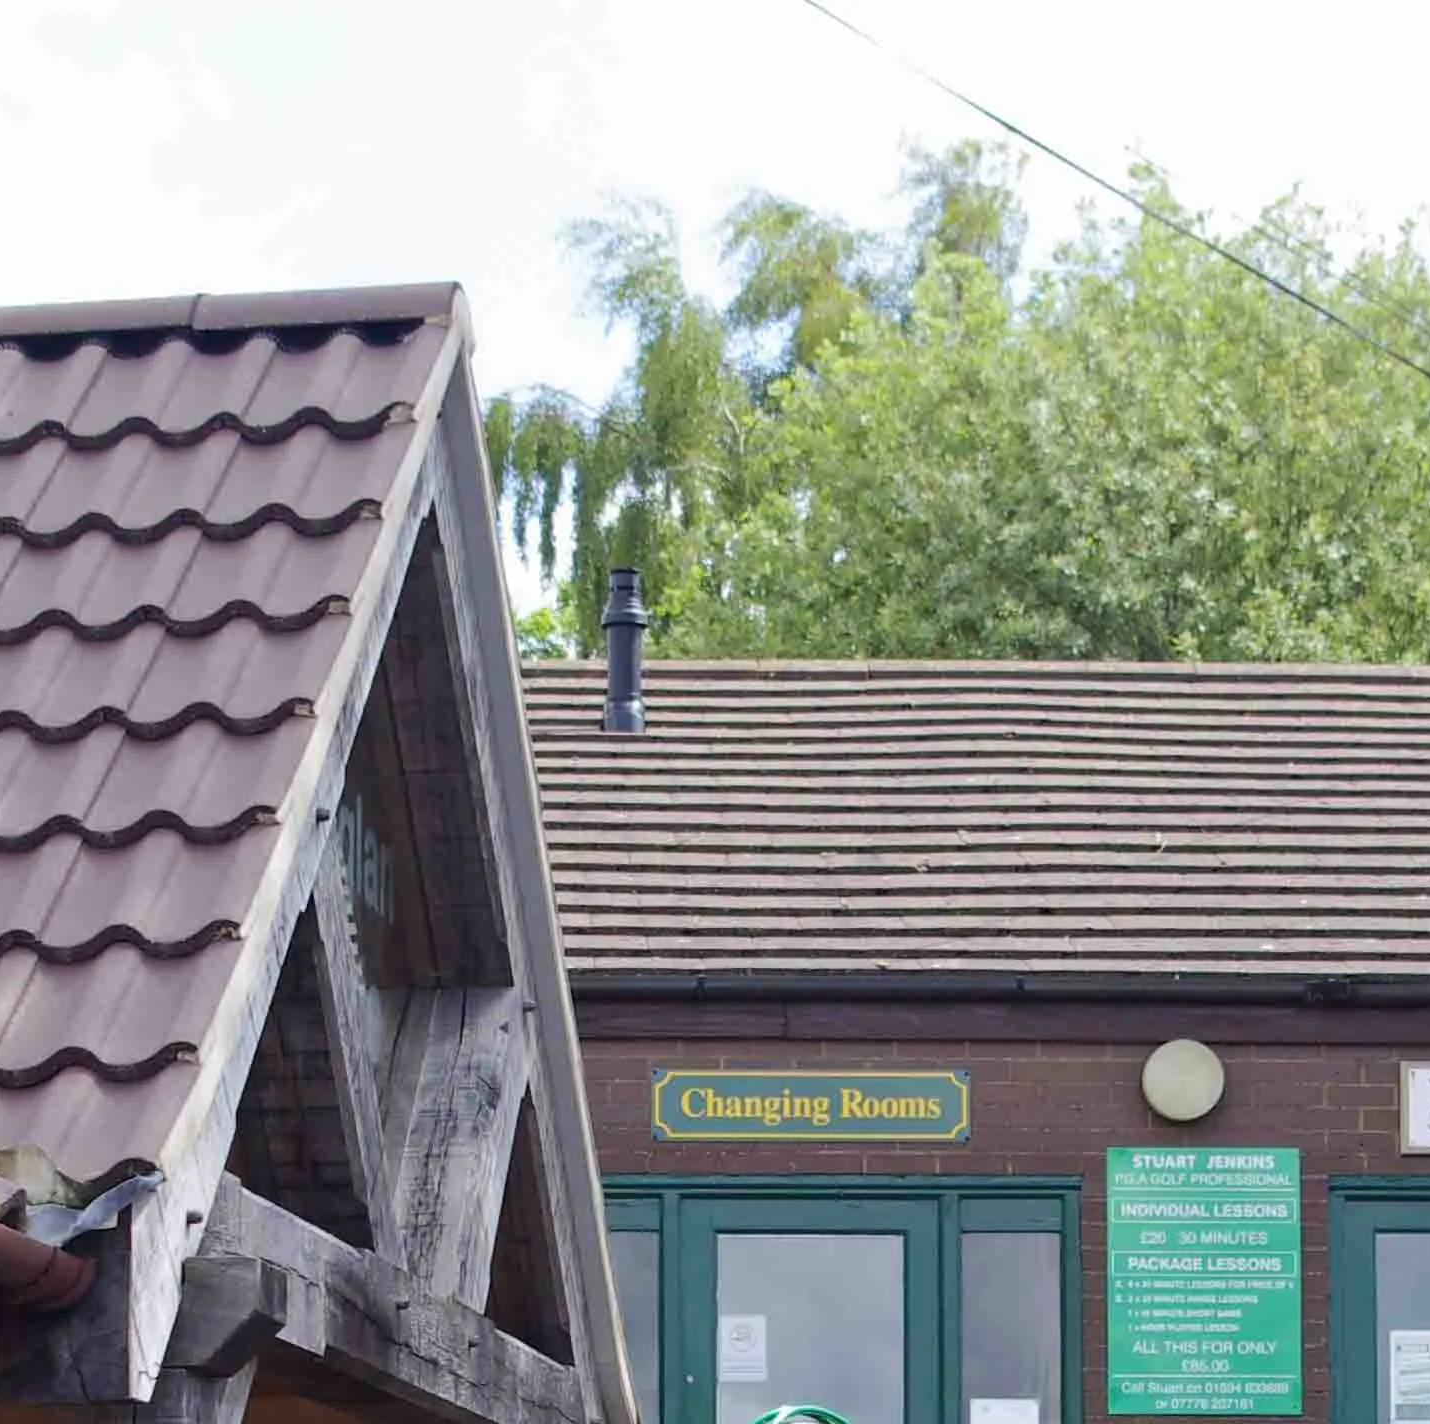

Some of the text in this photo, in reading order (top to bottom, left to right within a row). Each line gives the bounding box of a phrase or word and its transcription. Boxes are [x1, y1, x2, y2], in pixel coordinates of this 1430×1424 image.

[680, 1087, 942, 1127] Changing Rooms
[1131, 1154, 1276, 1170] STUART JENKINS
[1150, 1173, 1188, 1186] GOLF
[1190, 1173, 1292, 1187] PROFESSIONAL
[1120, 1203, 1289, 1218] INDIVIDUAL LESSONS
[1199, 1231, 1269, 1246] MINUTES
[1127, 1256, 1283, 1272] PACKAGE LESSONS
[1132, 1340, 1277, 1355] ALL THIS FOR ONLY
[1121, 1382, 1145, 1394] Call
[1155, 1400, 1168, 1409] or
